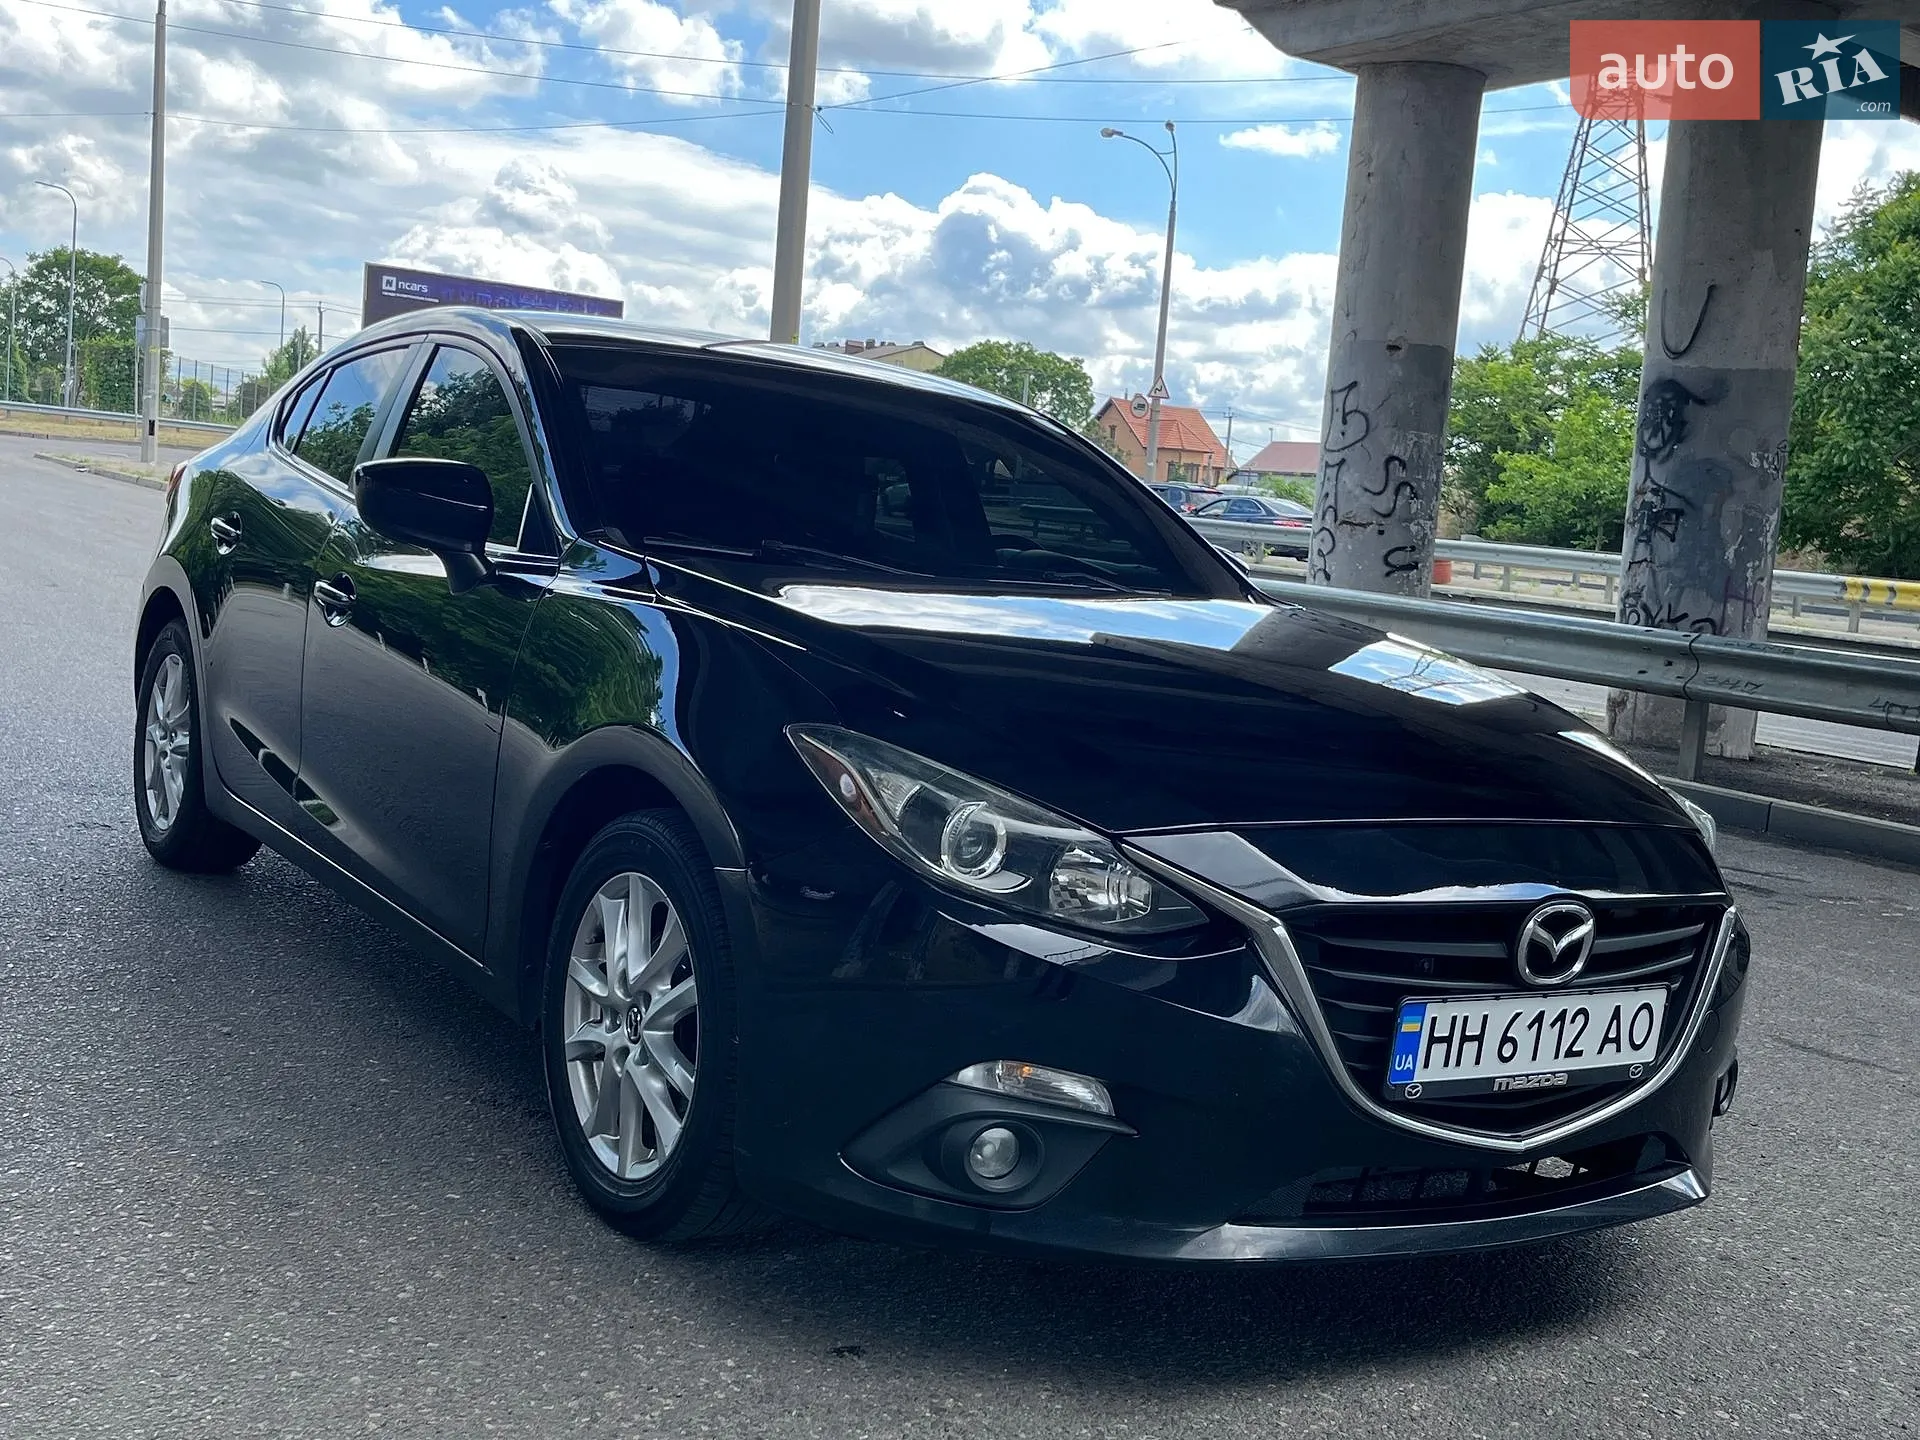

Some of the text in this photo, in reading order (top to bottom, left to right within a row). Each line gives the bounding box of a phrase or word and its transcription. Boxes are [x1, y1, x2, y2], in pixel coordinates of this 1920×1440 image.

[398, 281, 428, 293] ncars
[1422, 1001, 1654, 1070] HH 6112 AO
[1394, 1053, 1414, 1071] UA
[1492, 1072, 1569, 1092] mazda
